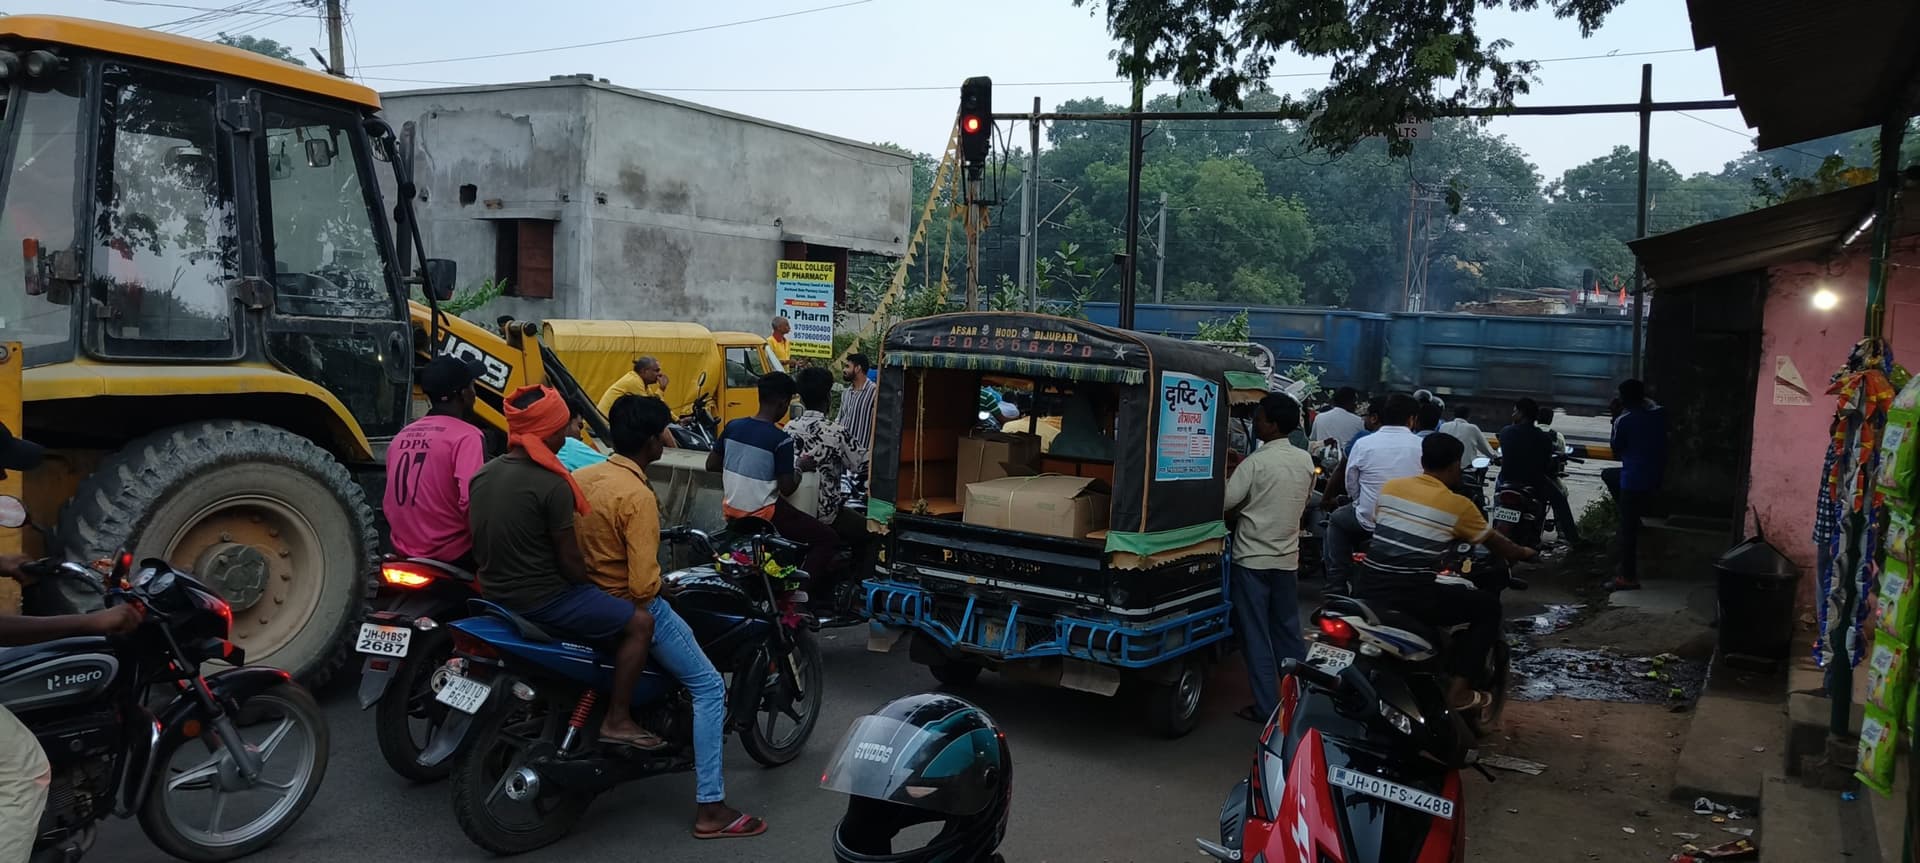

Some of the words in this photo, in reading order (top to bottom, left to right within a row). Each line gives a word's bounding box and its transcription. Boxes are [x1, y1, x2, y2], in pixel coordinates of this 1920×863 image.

[805, 263, 833, 272] COLLEGE
[781, 271, 791, 279] OF
[792, 272, 829, 280] PHARMACY
[794, 309, 830, 322] Pharm
[950, 325, 978, 336] AFSAR
[1032, 330, 1079, 343] BIJUPARA
[1164, 380, 1198, 411] दृष्टि
[399, 438, 432, 450] DPK
[394, 451, 427, 507] 07
[360, 640, 405, 654] 2687
[65, 670, 102, 685] Hero
[854, 742, 893, 763] STUDDS
